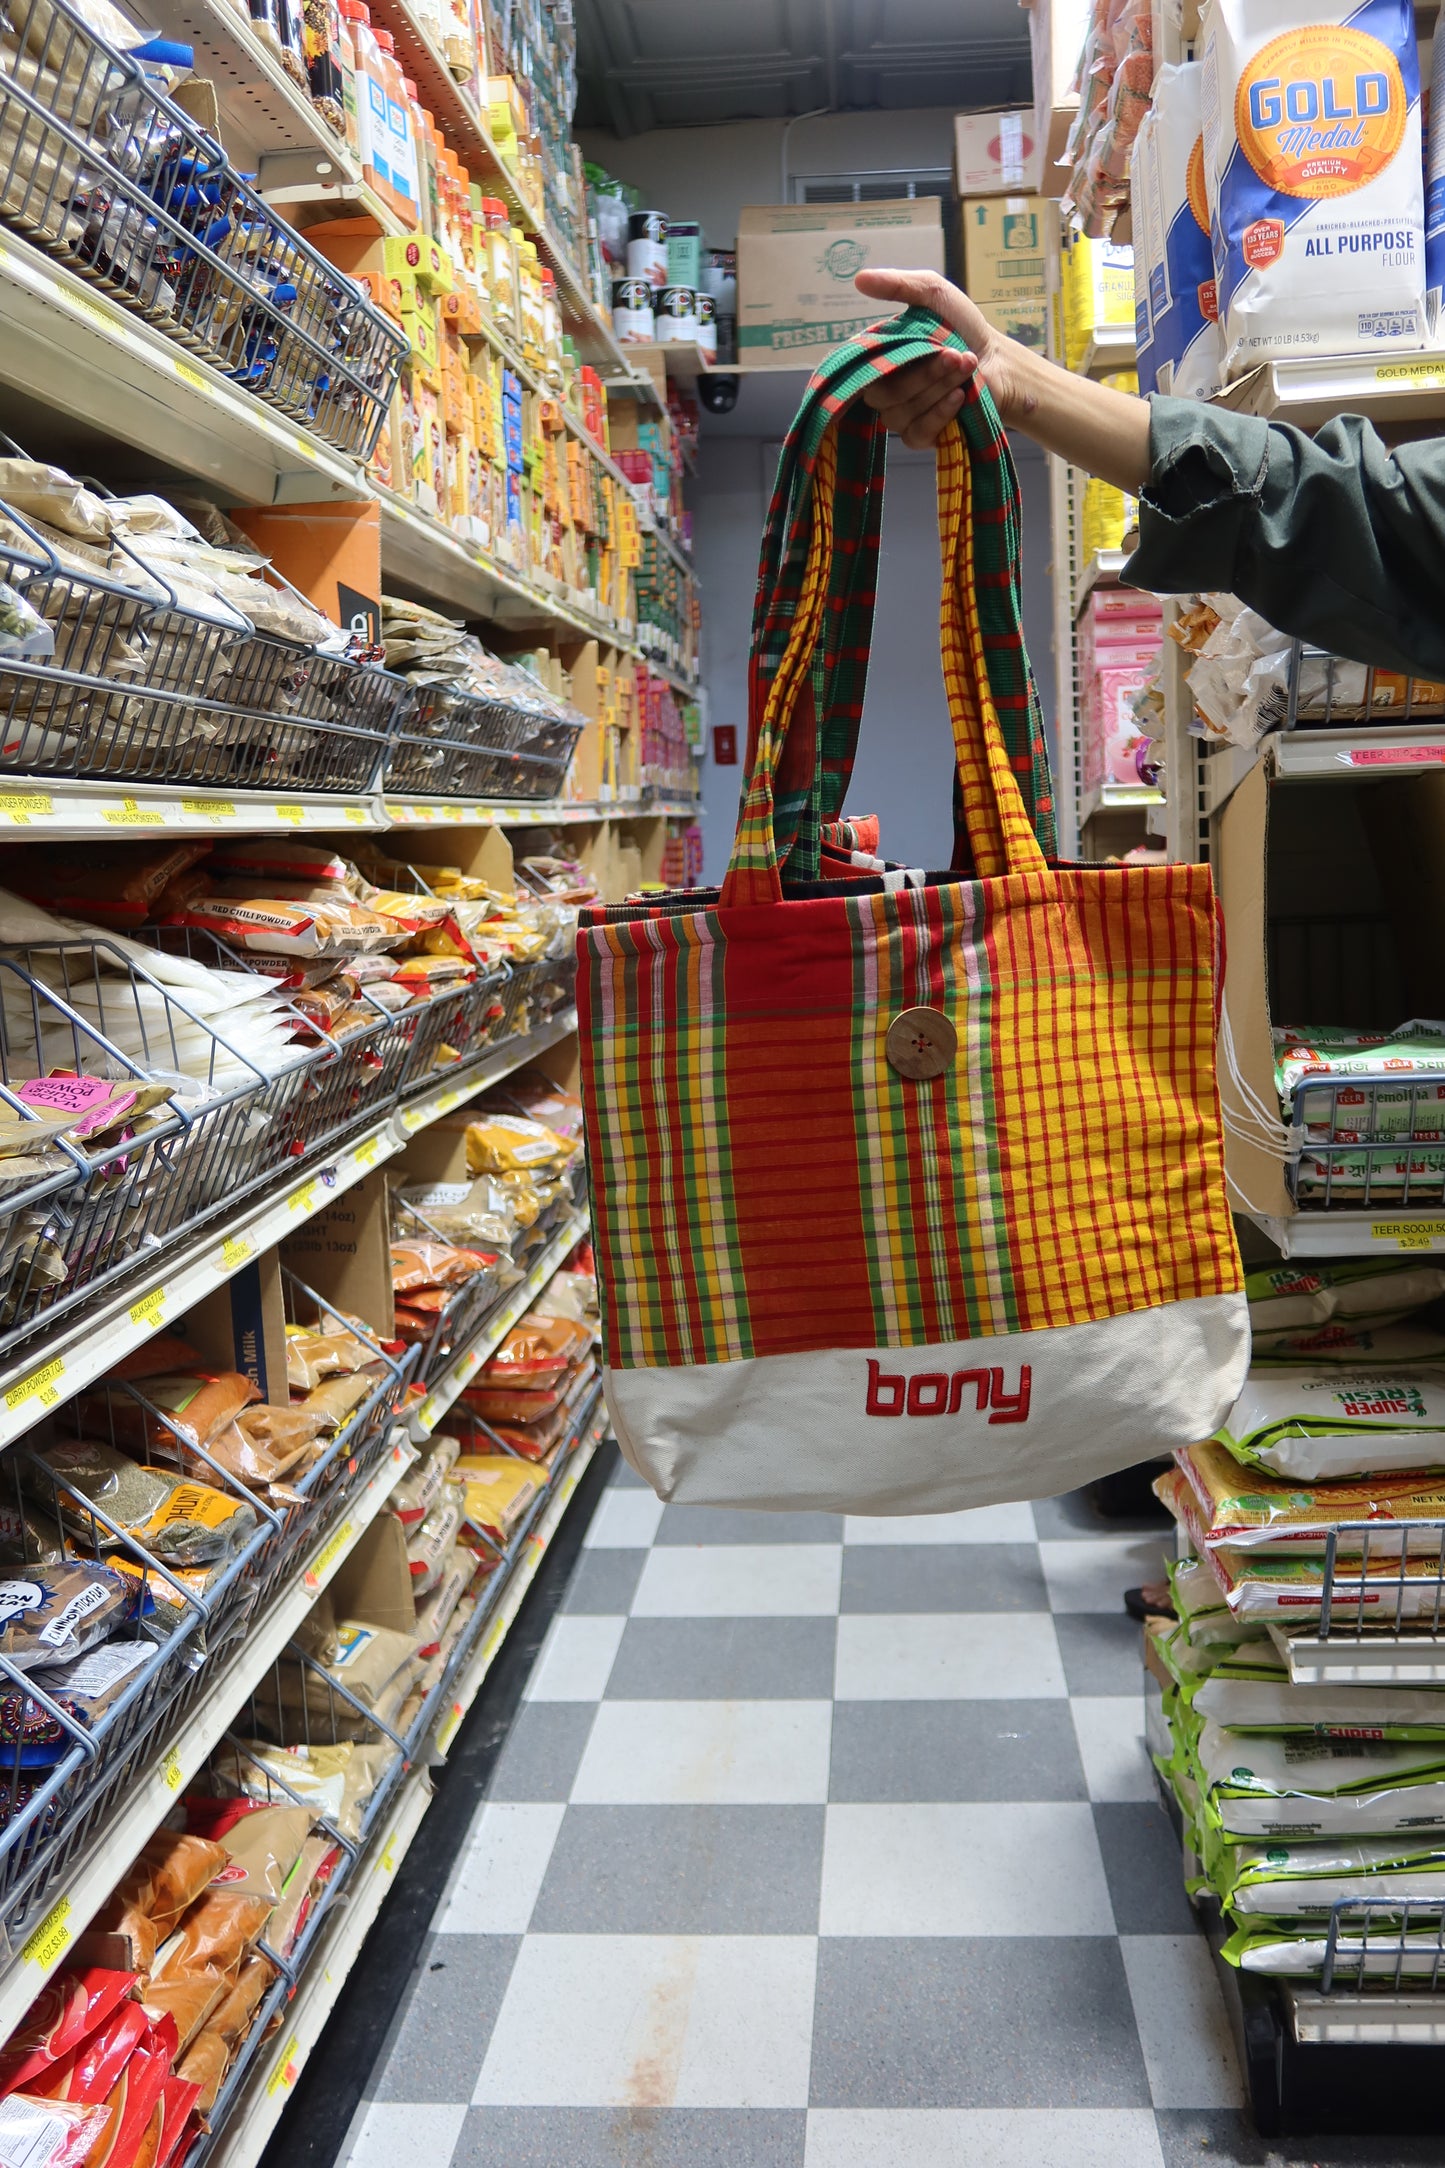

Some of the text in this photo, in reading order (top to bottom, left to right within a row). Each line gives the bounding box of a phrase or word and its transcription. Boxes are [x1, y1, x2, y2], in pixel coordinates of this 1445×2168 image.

[1300, 36, 1330, 45] MILLED
[1249, 72, 1390, 131] GOLD
[1277, 120, 1366, 159] Medal
[1307, 160, 1341, 168] PREMIUM
[1301, 166, 1348, 178] QUALITY
[1253, 226, 1271, 234] OVER
[1257, 230, 1279, 241] YEARS
[1305, 231, 1415, 257] ALL PURPOSE
[1382, 252, 1416, 267] FLOUR
[1098, 281, 1135, 292] GRANUL
[772, 325, 829, 349] FRESH
[1248, 336, 1261, 347] NET
[1262, 335, 1273, 346] WT
[1274, 335, 1282, 345] 10
[1283, 334, 1292, 344] LB
[211, 904, 293, 928] RED CHILI POWDER
[249, 959, 288, 968] POWDER
[1385, 1059, 1445, 1069] TEER Sem
[1338, 1094, 1362, 1103] TEER
[1414, 1131, 1438, 1141] TEER
[242, 1330, 257, 1363] Milk
[866, 1359, 1032, 1424] bony
[1336, 1387, 1421, 1403] FRESH
[1342, 1399, 1408, 1416] SUPER
[1412, 1495, 1433, 1503] NET
